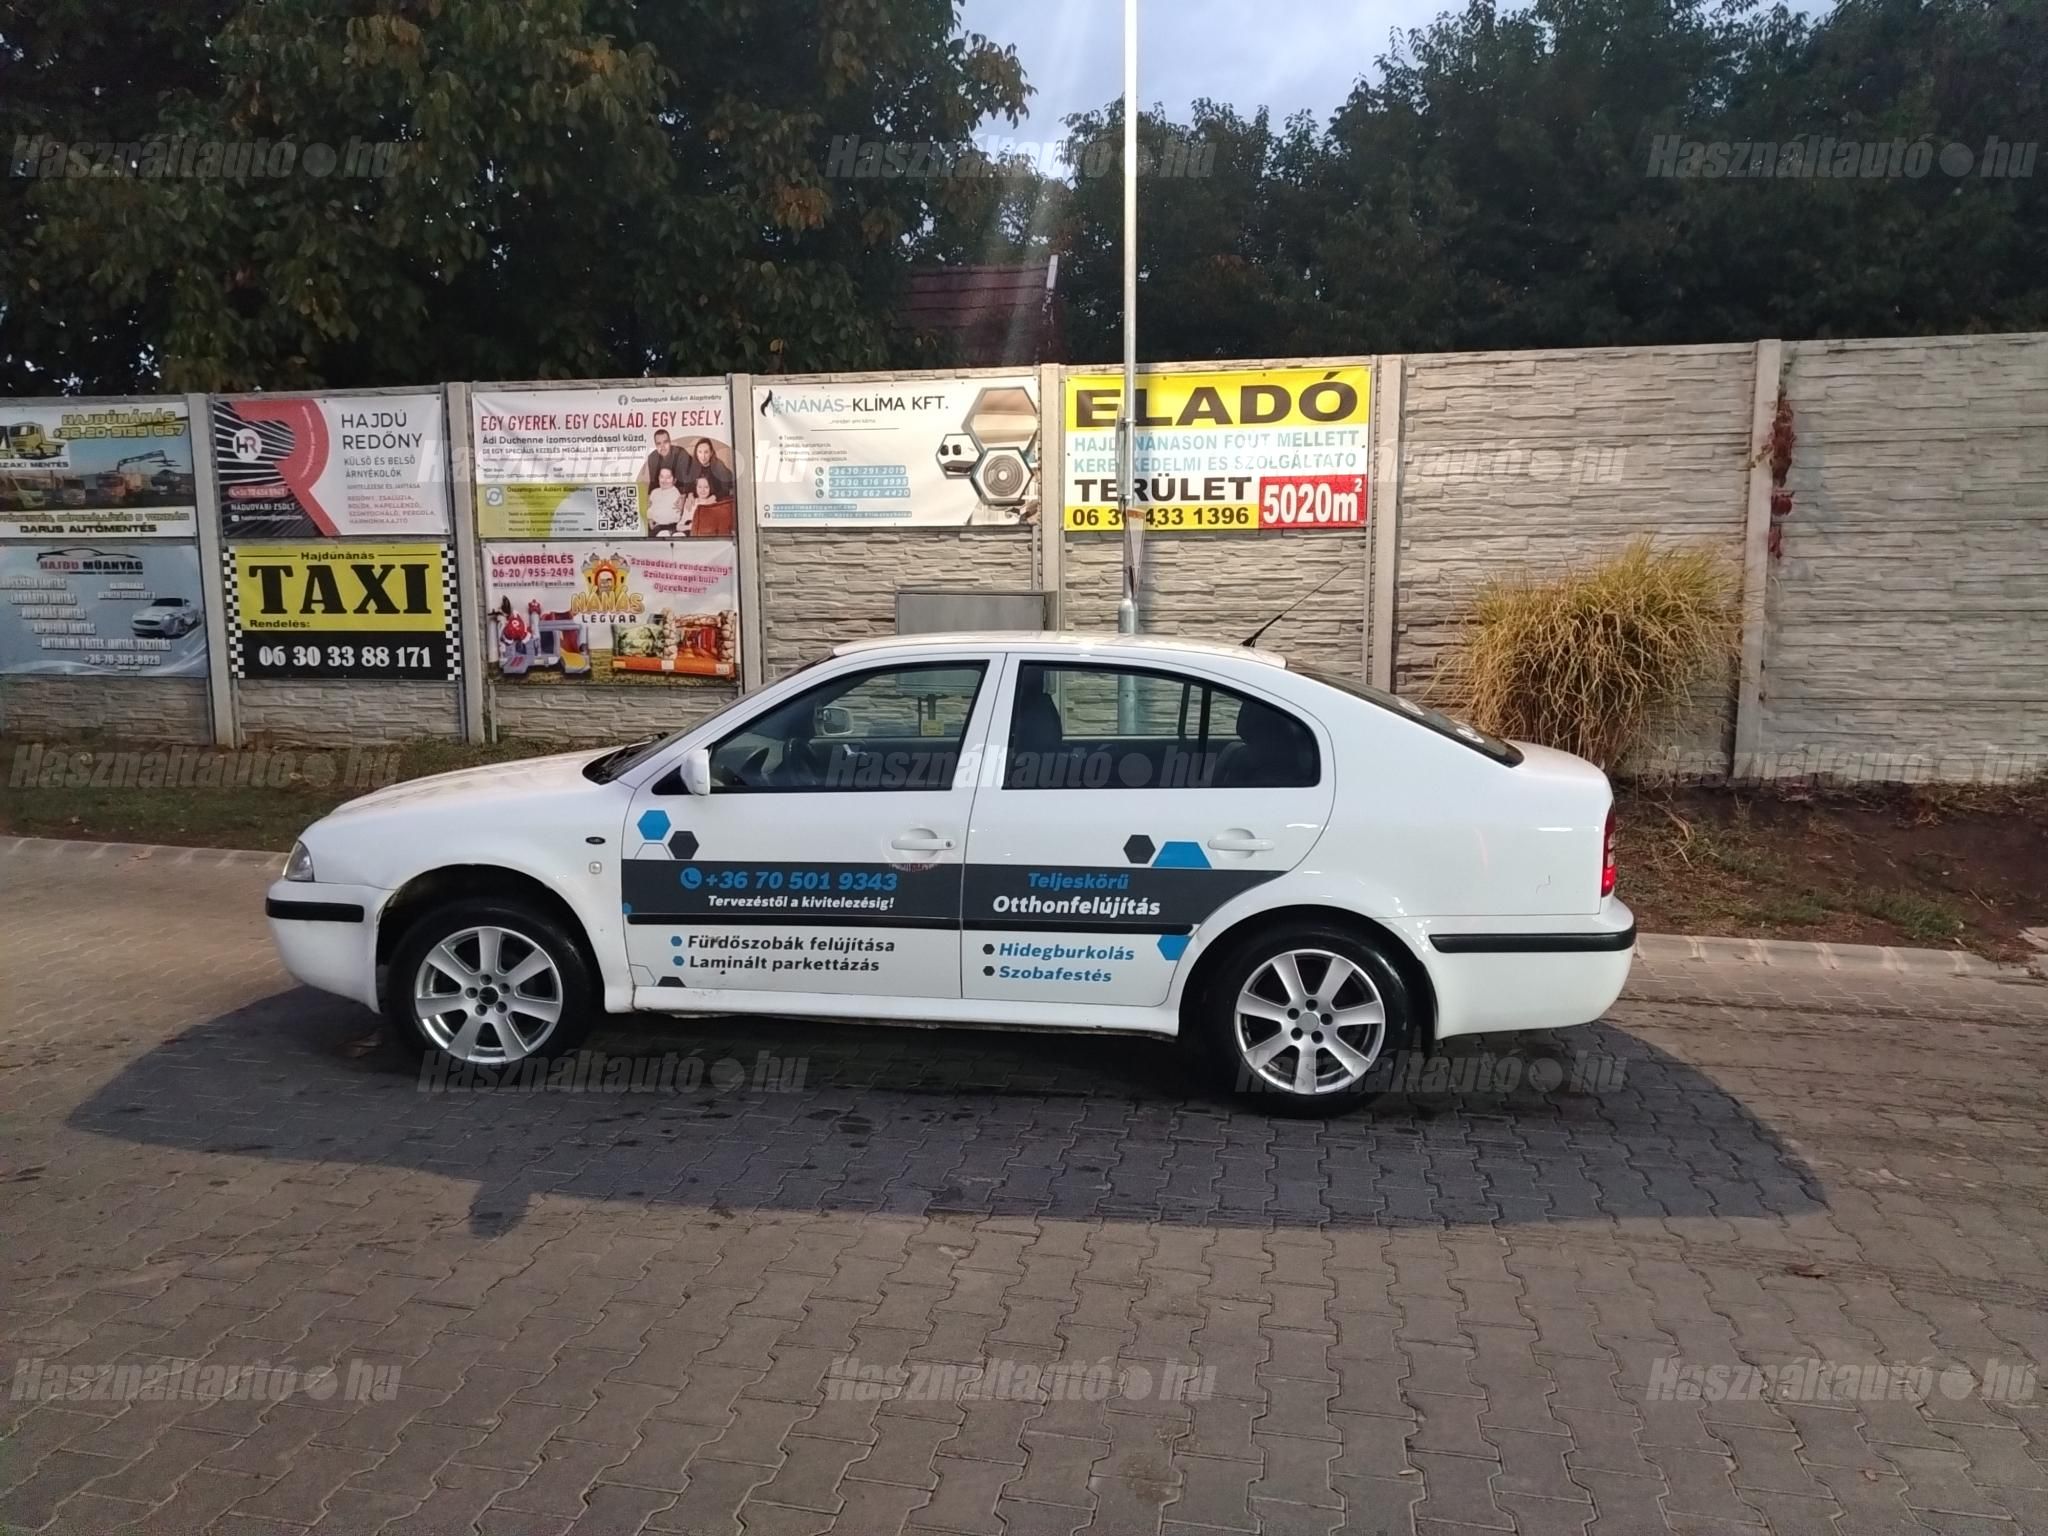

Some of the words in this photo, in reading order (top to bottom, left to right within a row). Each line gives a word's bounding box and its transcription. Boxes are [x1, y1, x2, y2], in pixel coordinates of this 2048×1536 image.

[1076, 372, 1358, 428] ELADÓ
[341, 409, 407, 429] HAJDÚ
[481, 415, 504, 432] EGY
[508, 414, 561, 431] GYEREK.
[565, 414, 588, 430] EGY
[593, 408, 648, 429] CSALÁD.
[652, 410, 677, 428] EGY
[681, 406, 724, 428] ESÉLY.
[343, 431, 423, 450] REDŐNY
[500, 435, 543, 444] Duchenne
[1277, 429, 1359, 447] MELLETT
[1072, 508, 1099, 526] 06
[1146, 508, 1184, 526] 433
[1193, 507, 1250, 525] 1396
[20, 525, 64, 534] DARUS
[301, 552, 375, 562] Hajdúnánás
[249, 564, 432, 614] TAXI
[250, 619, 311, 628] Rendelés:
[259, 646, 286, 666] 06
[293, 646, 321, 666] 30
[327, 646, 355, 666] 33
[361, 646, 390, 667] 88
[396, 647, 431, 667] 171
[706, 871, 748, 889] +36
[755, 871, 785, 889] 70
[788, 872, 831, 890] 501
[838, 872, 898, 891] 9343
[1028, 872, 1130, 891] Teljeskörű
[708, 895, 788, 908] Tervezéstől
[790, 898, 799, 908] a
[801, 896, 895, 911] kivitelezésig!
[992, 895, 1161, 918] Otthonfelújítás
[688, 935, 804, 950] Fürdőszobák
[810, 936, 896, 954] felújítása
[999, 942, 1135, 962] Hidegburkolás
[689, 955, 767, 971] Laminált
[772, 957, 880, 974] parkettázás
[999, 966, 1113, 983] Szobafestés
